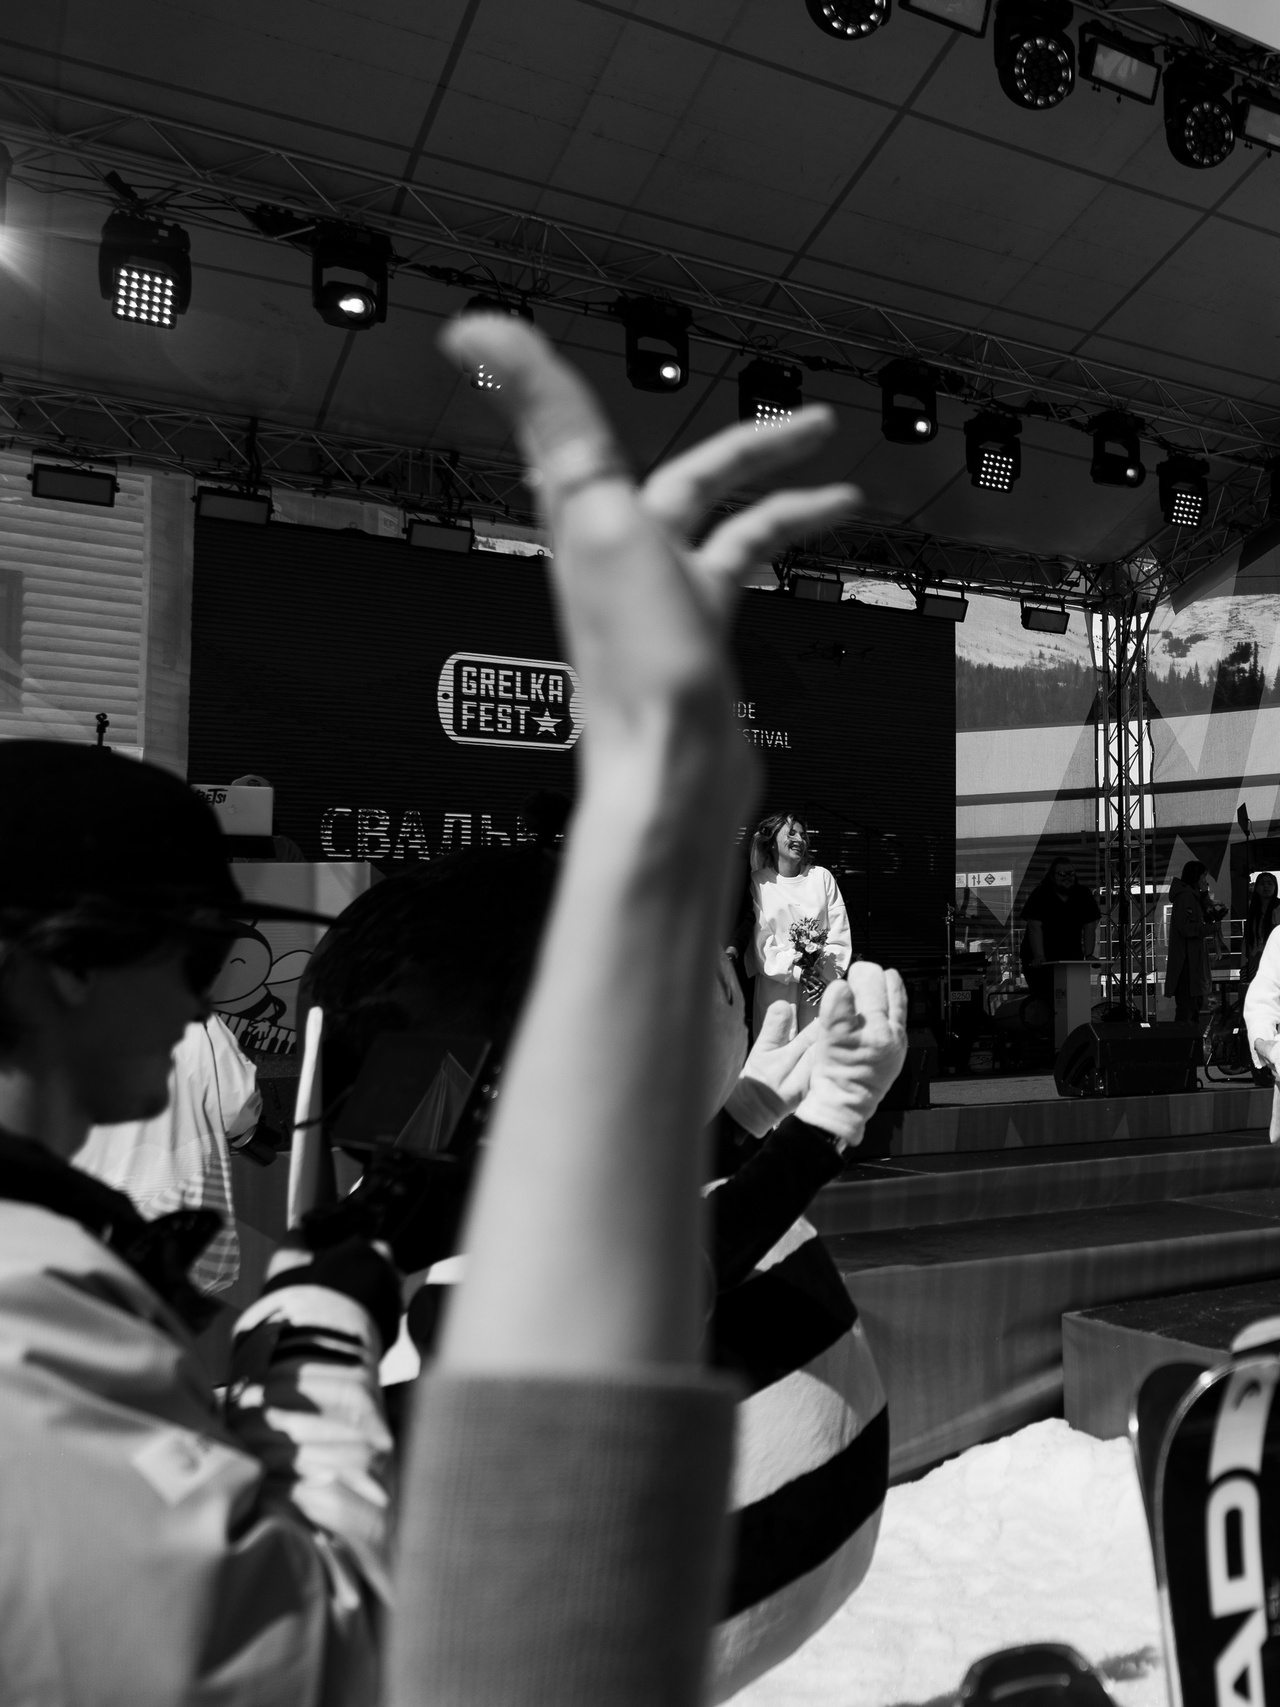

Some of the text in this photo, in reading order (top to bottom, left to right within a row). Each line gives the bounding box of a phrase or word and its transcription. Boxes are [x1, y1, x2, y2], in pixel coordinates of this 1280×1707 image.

[462, 666, 563, 703] GRELKA
[462, 701, 530, 734] FEST
[732, 701, 756, 719] IDE
[737, 728, 792, 749] STIVAL
[951, 992, 971, 1001] S250
